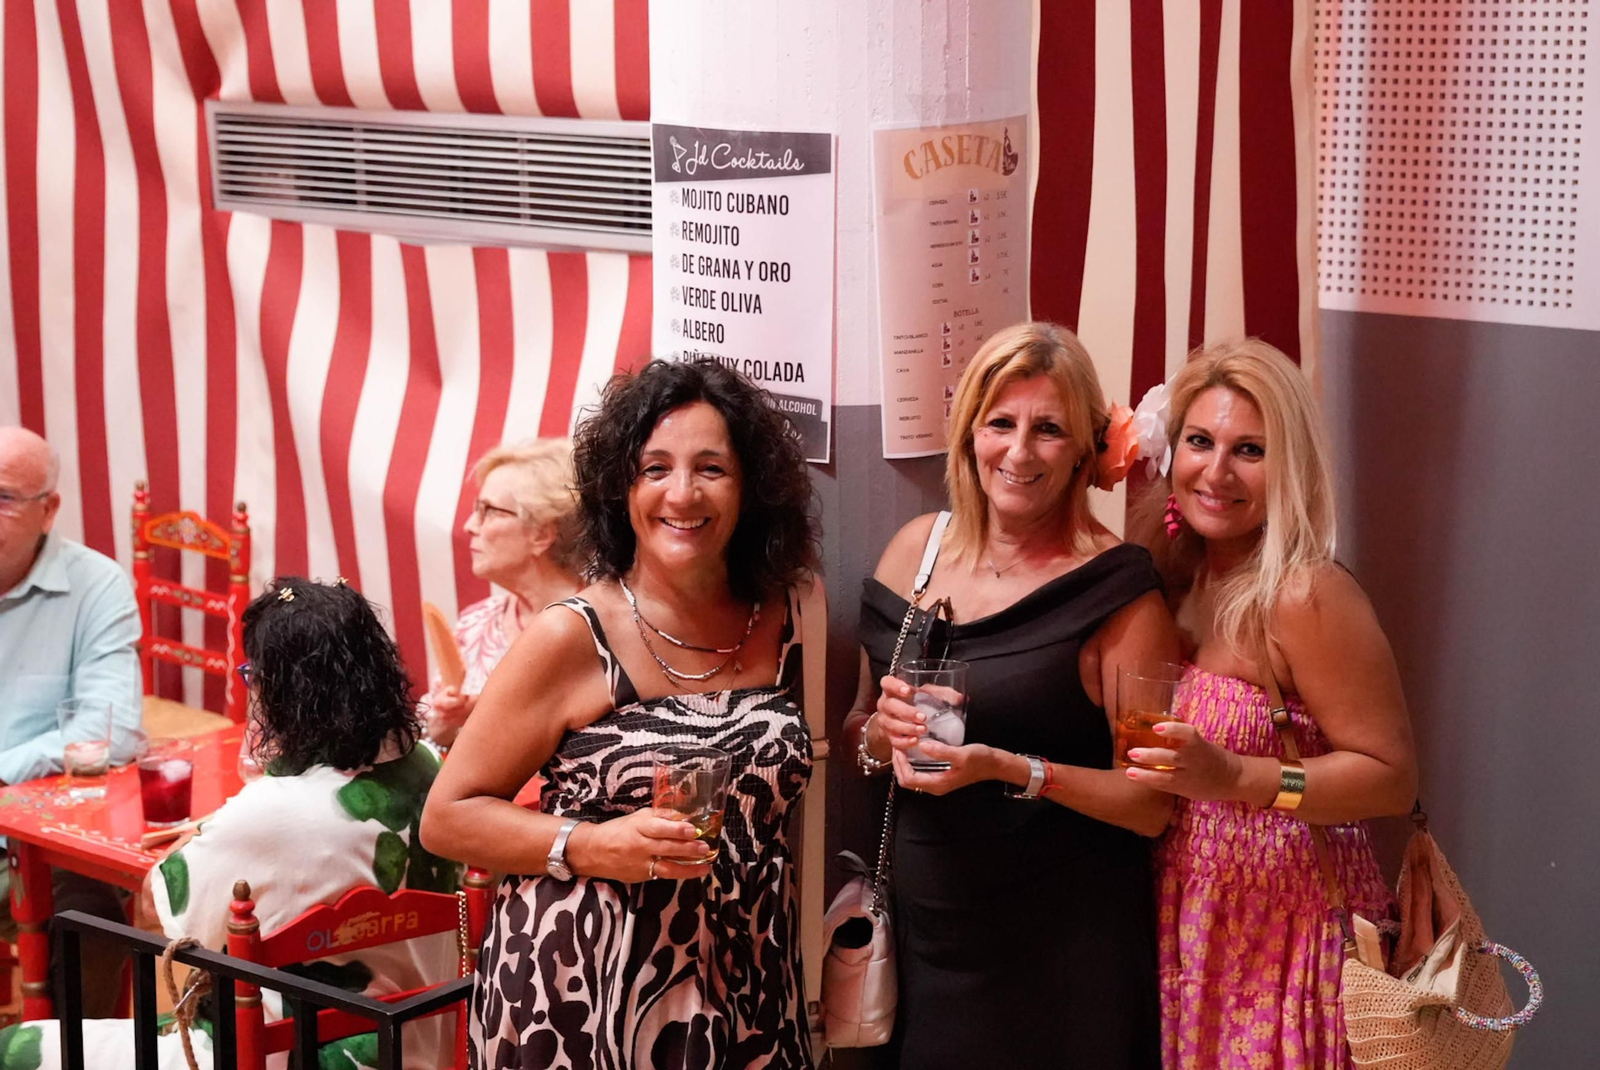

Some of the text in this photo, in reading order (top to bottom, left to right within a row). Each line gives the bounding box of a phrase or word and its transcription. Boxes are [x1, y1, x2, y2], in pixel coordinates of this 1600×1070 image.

[711, 143, 804, 171] Cocktails
[903, 134, 1003, 180] CASETA
[682, 187, 789, 216] MOJITO CUBANO
[682, 221, 740, 247] REMOJITO
[682, 253, 791, 283] DE GRANA Y ORO
[682, 285, 763, 315] VERDE OLIVA
[953, 308, 979, 318] BOTELLA
[682, 318, 725, 344] ALBERO
[743, 359, 805, 383] COLADA
[778, 399, 817, 416] ALCOHOL
[896, 395, 919, 403] CERVEZA
